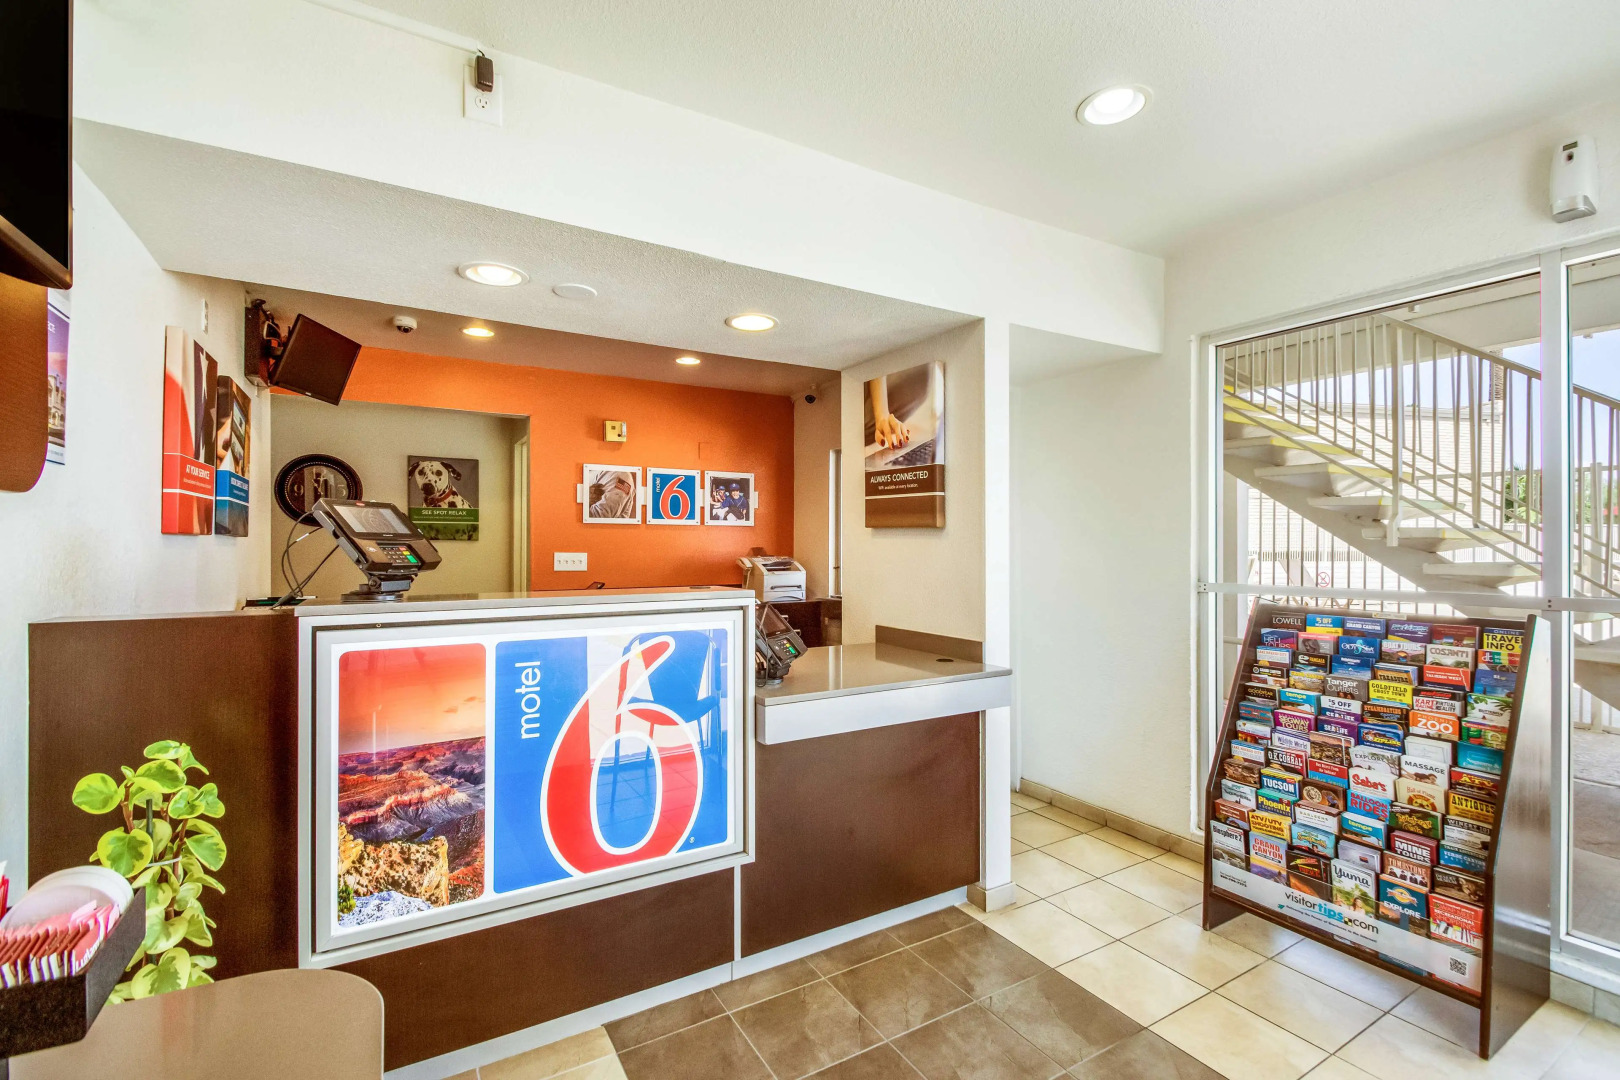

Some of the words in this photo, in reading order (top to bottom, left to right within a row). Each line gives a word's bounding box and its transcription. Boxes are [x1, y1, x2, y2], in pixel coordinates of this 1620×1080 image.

[870, 474, 891, 484] ALWAYS
[892, 470, 928, 482] CONNECTED
[660, 476, 690, 520] 6
[1272, 616, 1302, 626] LOWELL
[1430, 647, 1469, 659] COSANTI
[1486, 644, 1515, 652] INFO
[1325, 677, 1358, 690] Tanger
[1326, 682, 1359, 696] Outlets
[1371, 682, 1408, 694] GOLDFIELD
[515, 661, 540, 740] motel
[1285, 692, 1306, 700] tempe
[1374, 688, 1388, 696] GHOST
[1391, 690, 1406, 698] TOWN
[1414, 698, 1434, 708] KART
[1278, 716, 1310, 728] SEGWAY
[1418, 714, 1453, 725] PHOENIX
[1418, 718, 1453, 734] ZOO
[1282, 722, 1309, 733] TOURS
[1278, 736, 1294, 747] Wildlife
[1294, 740, 1308, 750] World
[540, 635, 704, 878] 6
[1279, 754, 1303, 767] CORRAL
[1404, 760, 1446, 775] MASSAGE
[1262, 776, 1295, 793] TUCSON
[1352, 773, 1387, 792] Saba's
[1258, 796, 1291, 812] Phoenix
[1350, 792, 1388, 809] BALLOON
[1452, 794, 1496, 815] ANTIQUES
[1350, 798, 1388, 819] RIDES
[1212, 825, 1238, 840] Biosphere
[1348, 819, 1372, 832] tempe
[1252, 844, 1284, 861] CANYON
[1254, 837, 1280, 853] GRAND
[1395, 840, 1431, 858] MINE
[1396, 848, 1431, 864] TOURS
[1388, 857, 1426, 876] TOMBSTONE
[1333, 864, 1371, 888] Yuma
[1384, 900, 1422, 920] EXPLORE
